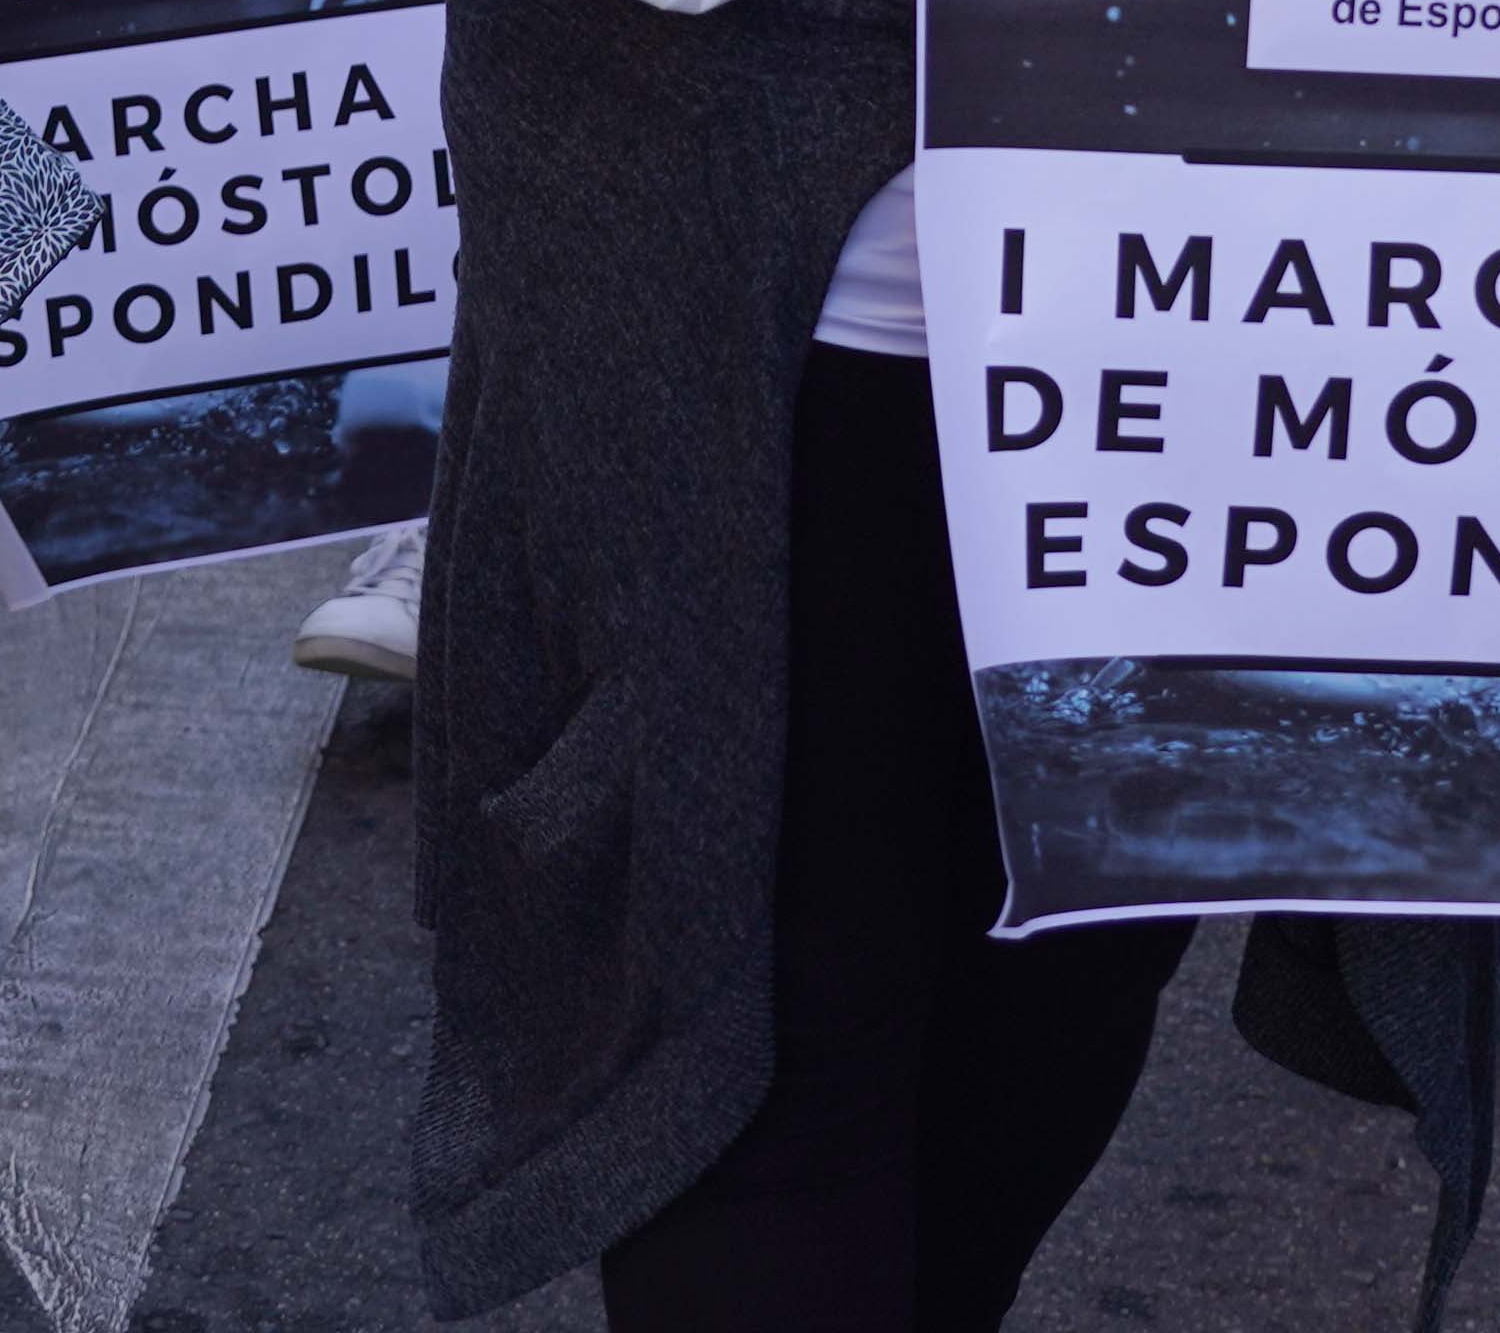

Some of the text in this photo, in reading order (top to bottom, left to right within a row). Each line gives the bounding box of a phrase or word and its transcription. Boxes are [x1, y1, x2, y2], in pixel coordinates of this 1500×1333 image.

[42, 63, 396, 162] ARCHA
[1000, 228, 1025, 316] I
[985, 365, 1169, 453] DE
